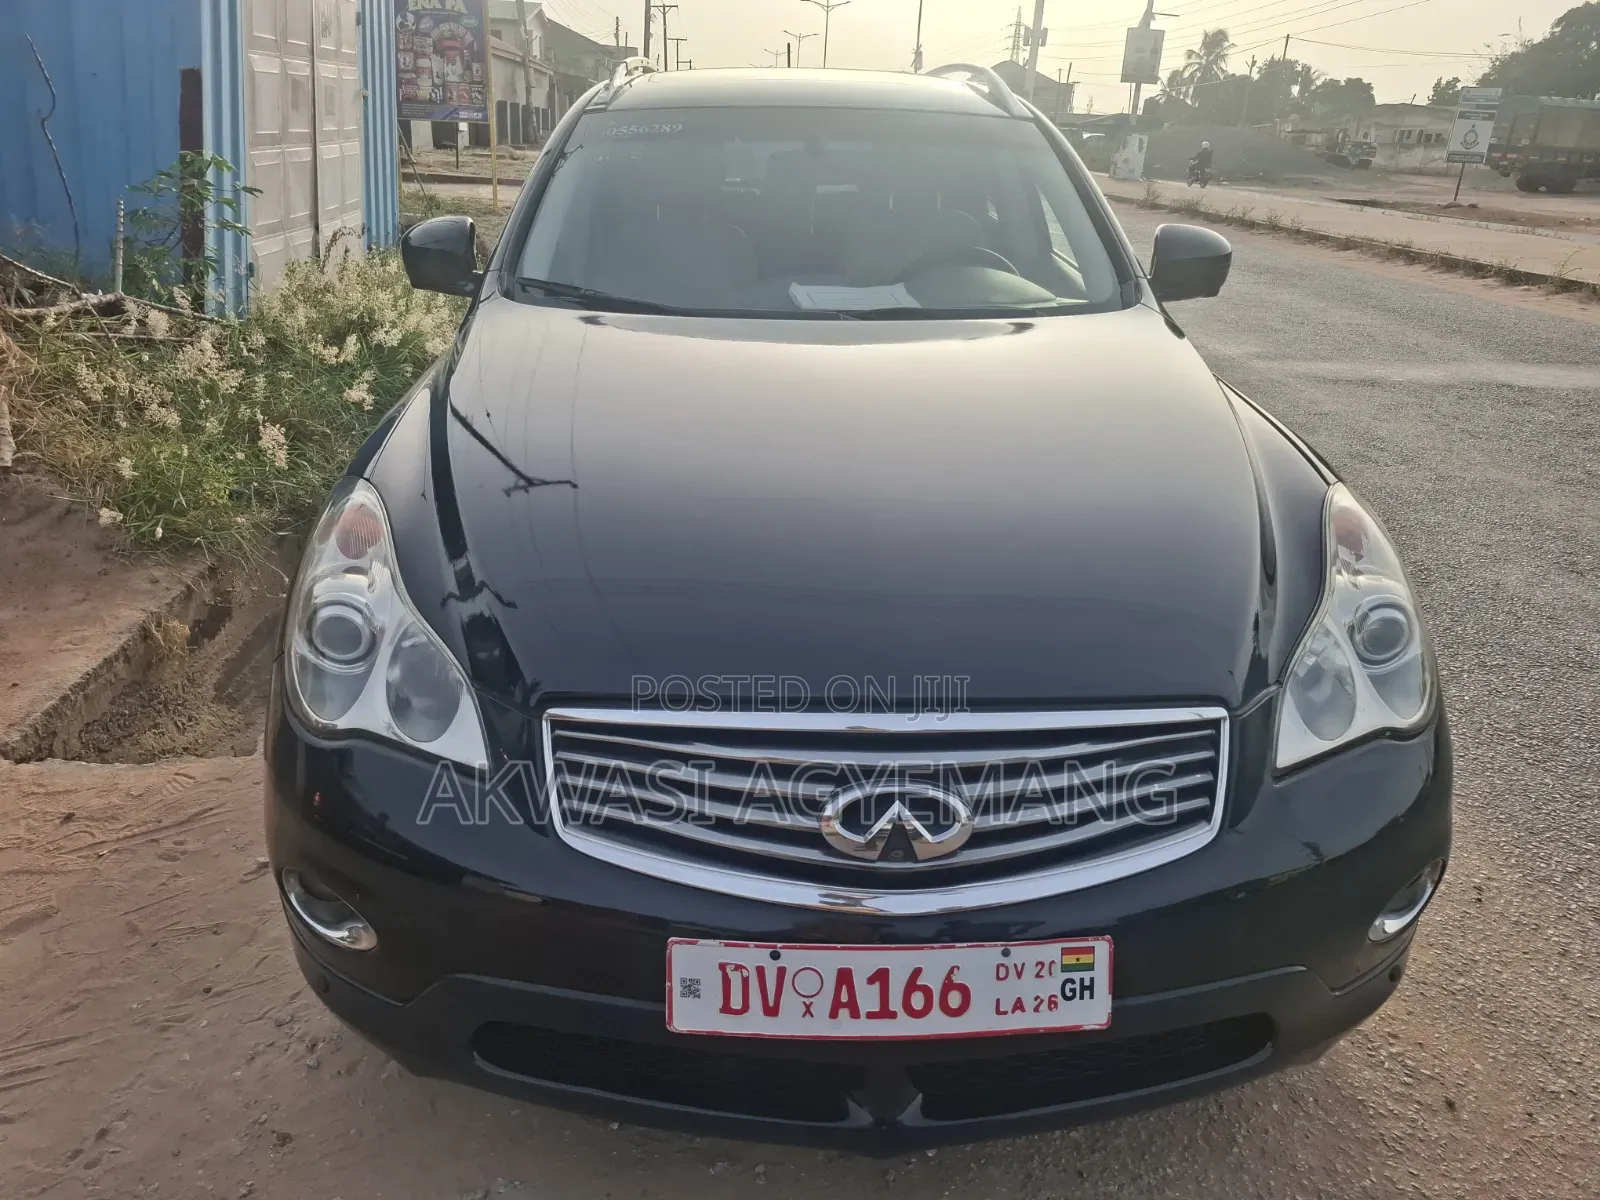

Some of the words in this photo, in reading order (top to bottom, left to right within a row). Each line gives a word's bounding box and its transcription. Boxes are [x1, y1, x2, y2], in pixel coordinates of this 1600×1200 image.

[995, 962, 1026, 982] DV
[718, 961, 788, 1018] DV
[828, 965, 972, 1020] A166
[1060, 976, 1095, 1002] GH
[995, 996, 1027, 1016] LA
